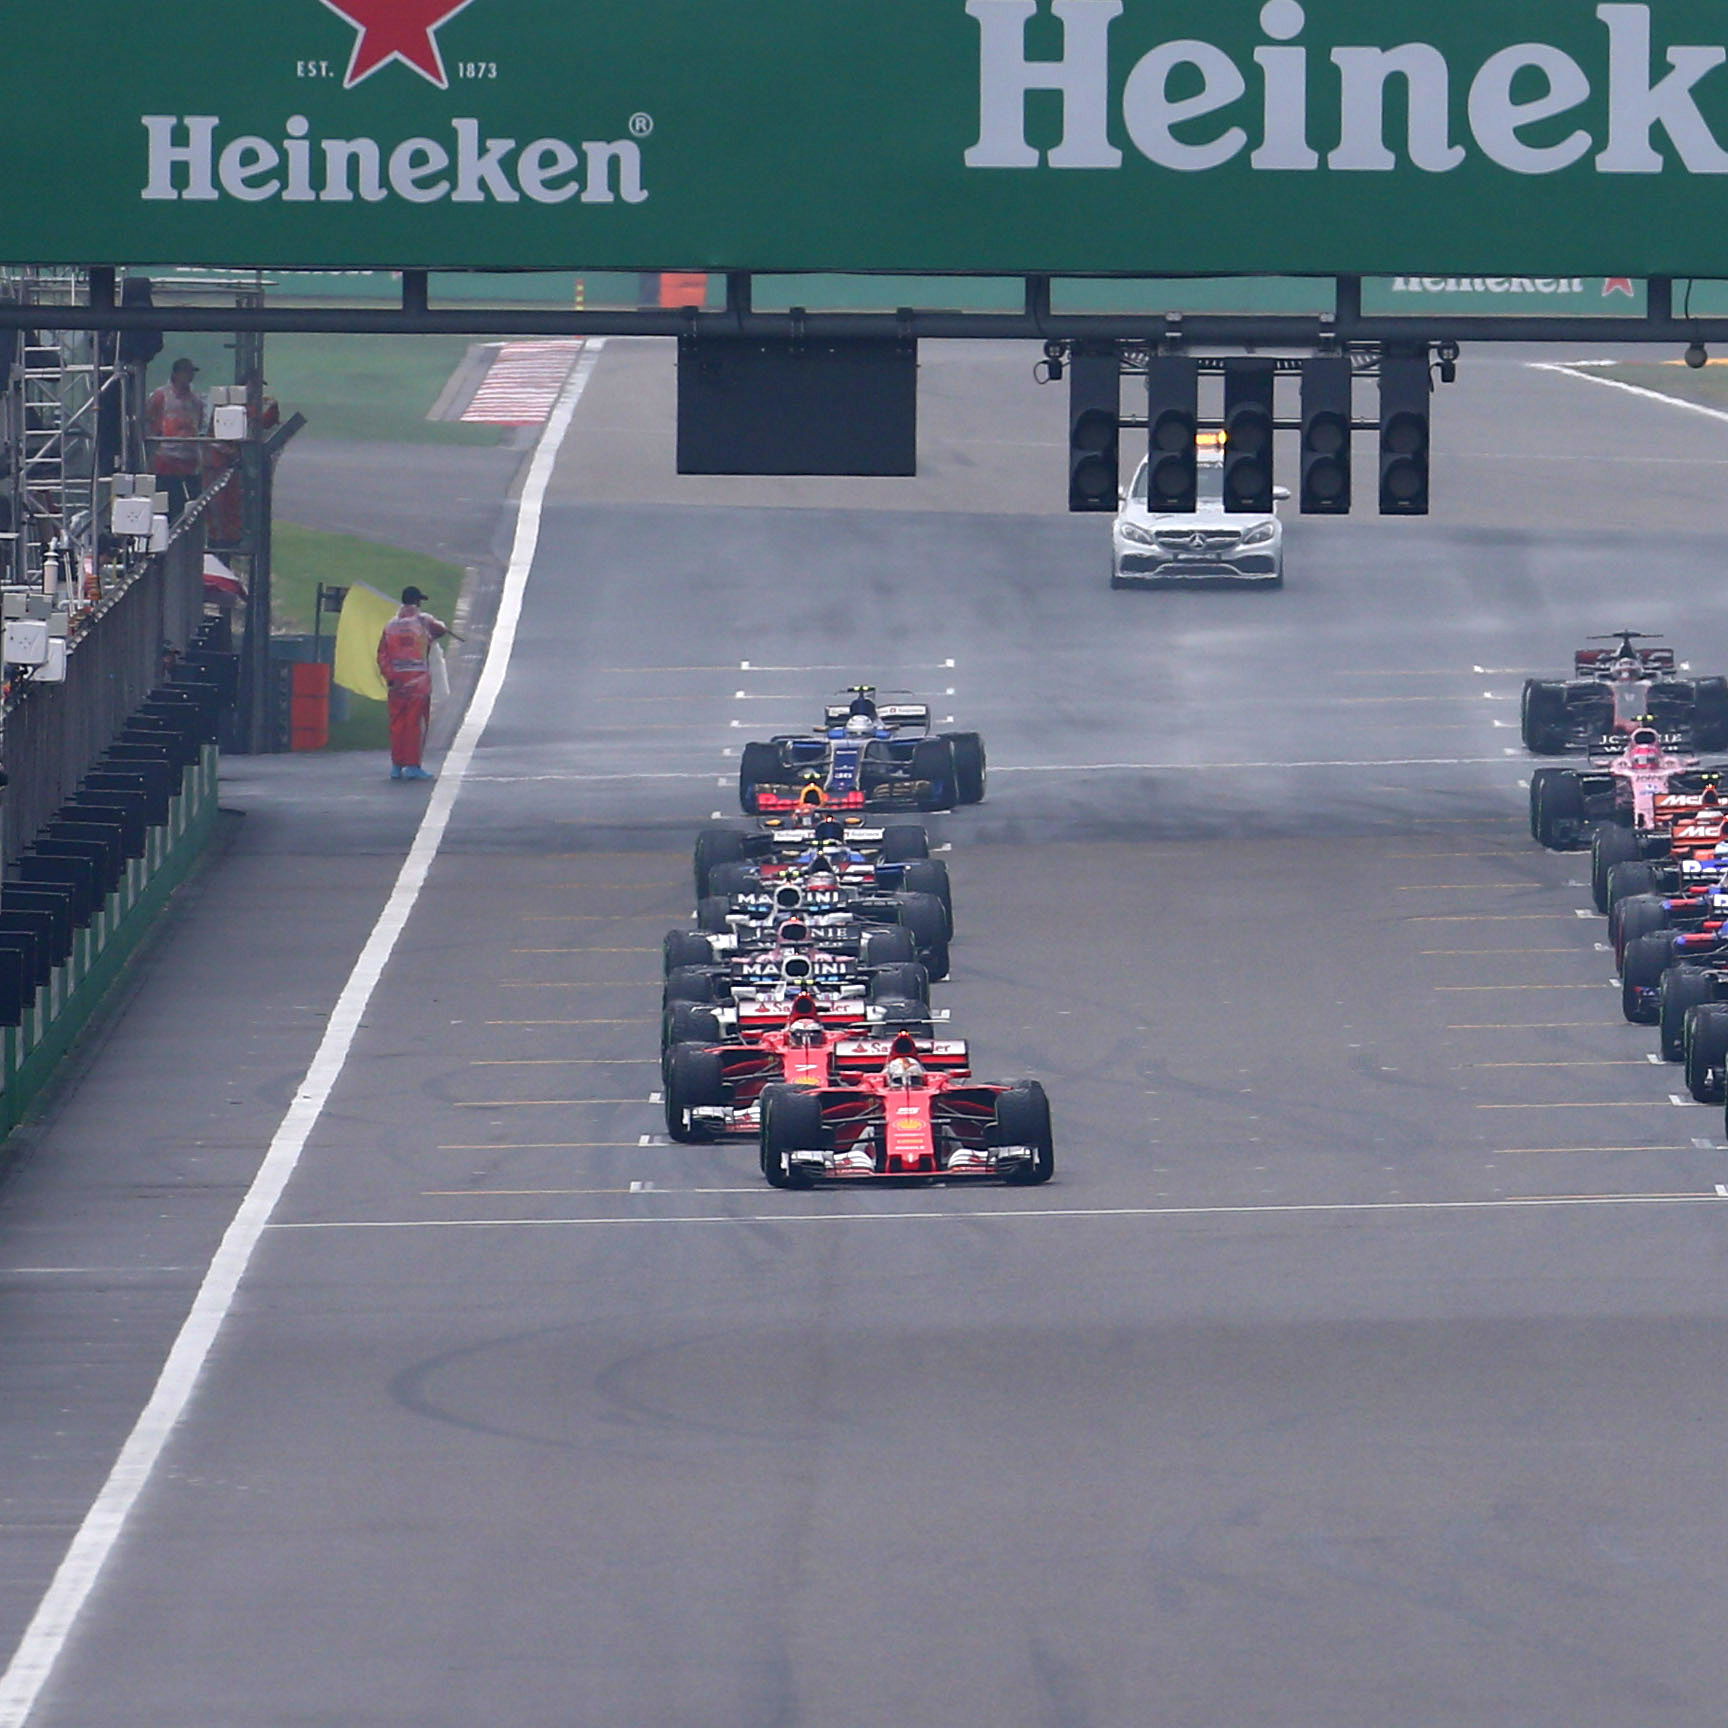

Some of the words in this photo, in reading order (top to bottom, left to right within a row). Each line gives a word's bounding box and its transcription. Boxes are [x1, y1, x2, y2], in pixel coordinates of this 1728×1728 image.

[297, 61, 334, 77] EST.
[458, 62, 498, 78] 1873
[737, 892, 839, 904] MAINI
[742, 962, 847, 975] MAINI
